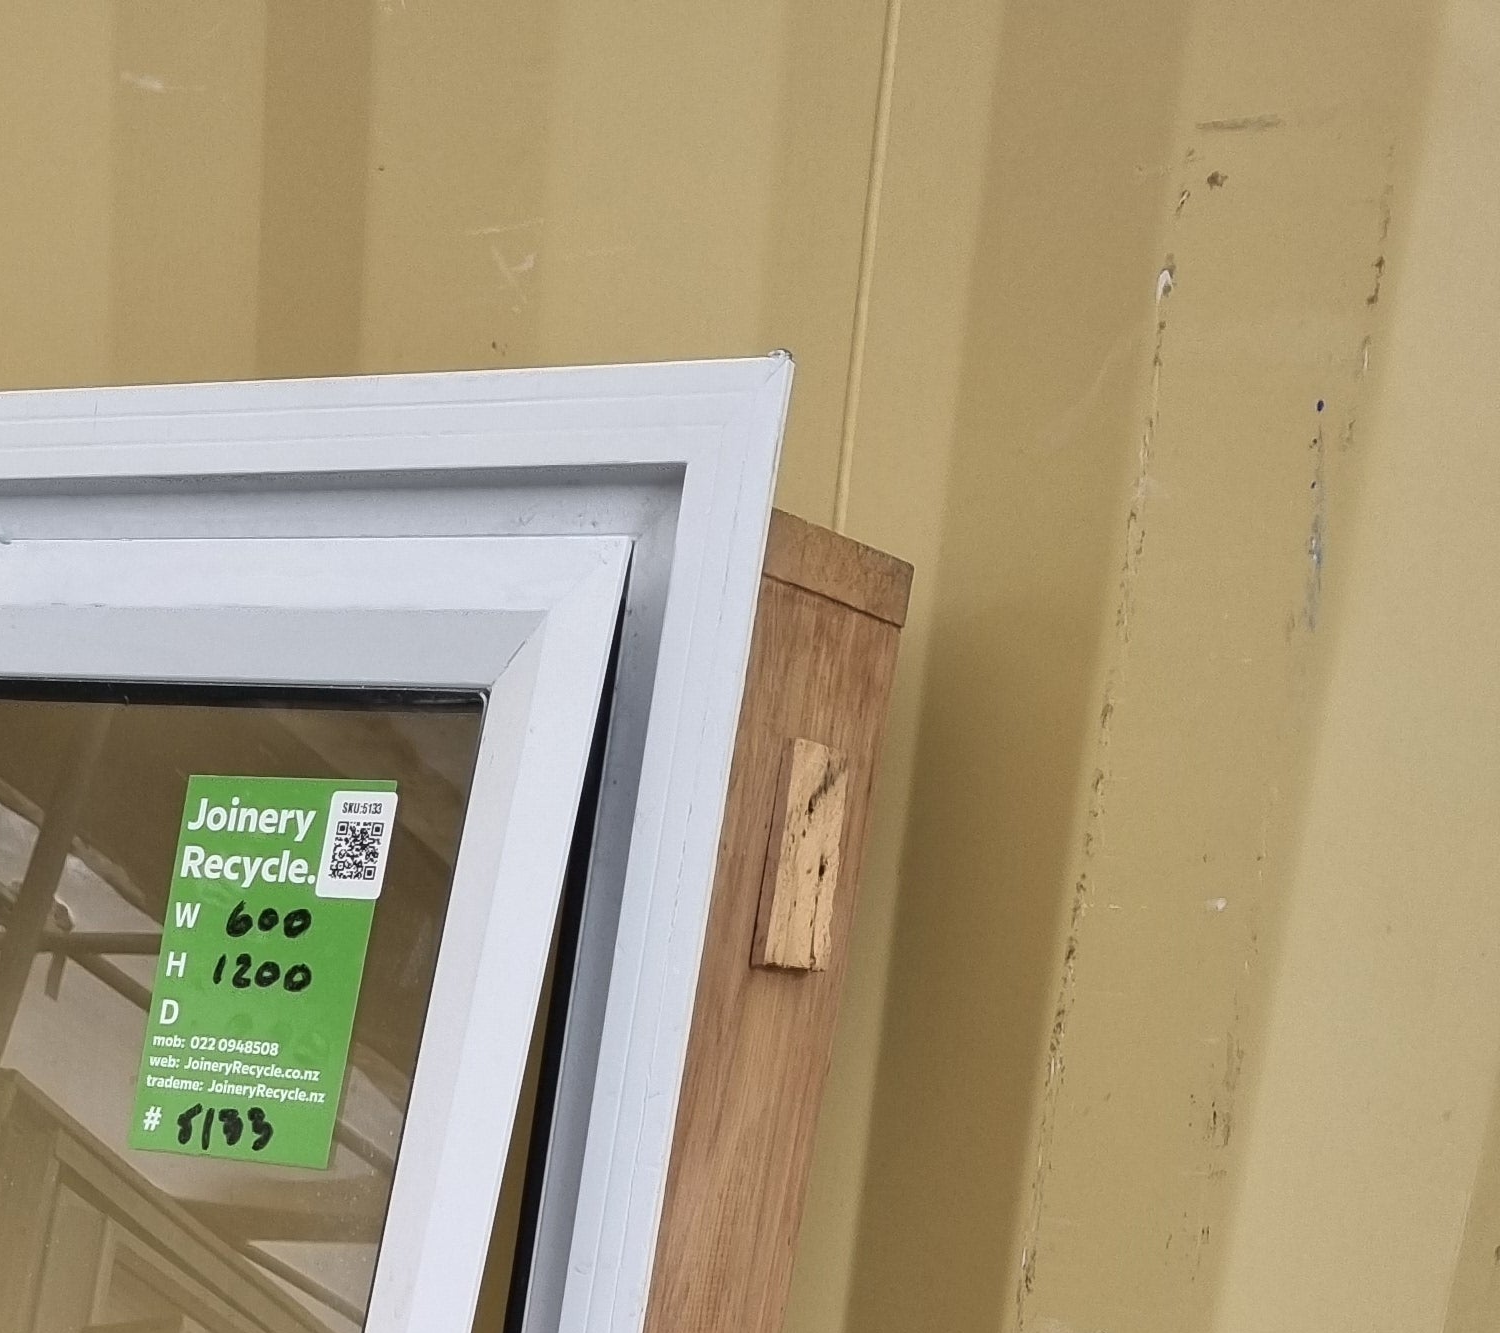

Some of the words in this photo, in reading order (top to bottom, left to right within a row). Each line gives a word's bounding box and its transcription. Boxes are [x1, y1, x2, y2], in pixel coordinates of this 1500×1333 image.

[187, 797, 316, 841] Joinery
[341, 801, 383, 815] SKU:5133
[180, 845, 316, 888] Recycle.
[175, 902, 200, 929] W
[226, 900, 312, 938] 600
[166, 951, 186, 978] H
[212, 953, 312, 992] 1200
[159, 999, 179, 1025] D
[152, 1034, 186, 1050] mob:
[190, 1037, 215, 1051] 022
[217, 1038, 279, 1056] 0948508
[149, 1055, 180, 1070] web:
[184, 1057, 320, 1081] JoineryRecycle.co.nz
[146, 1075, 203, 1092] trademe:
[207, 1079, 325, 1103] JoineryRecycle.nz
